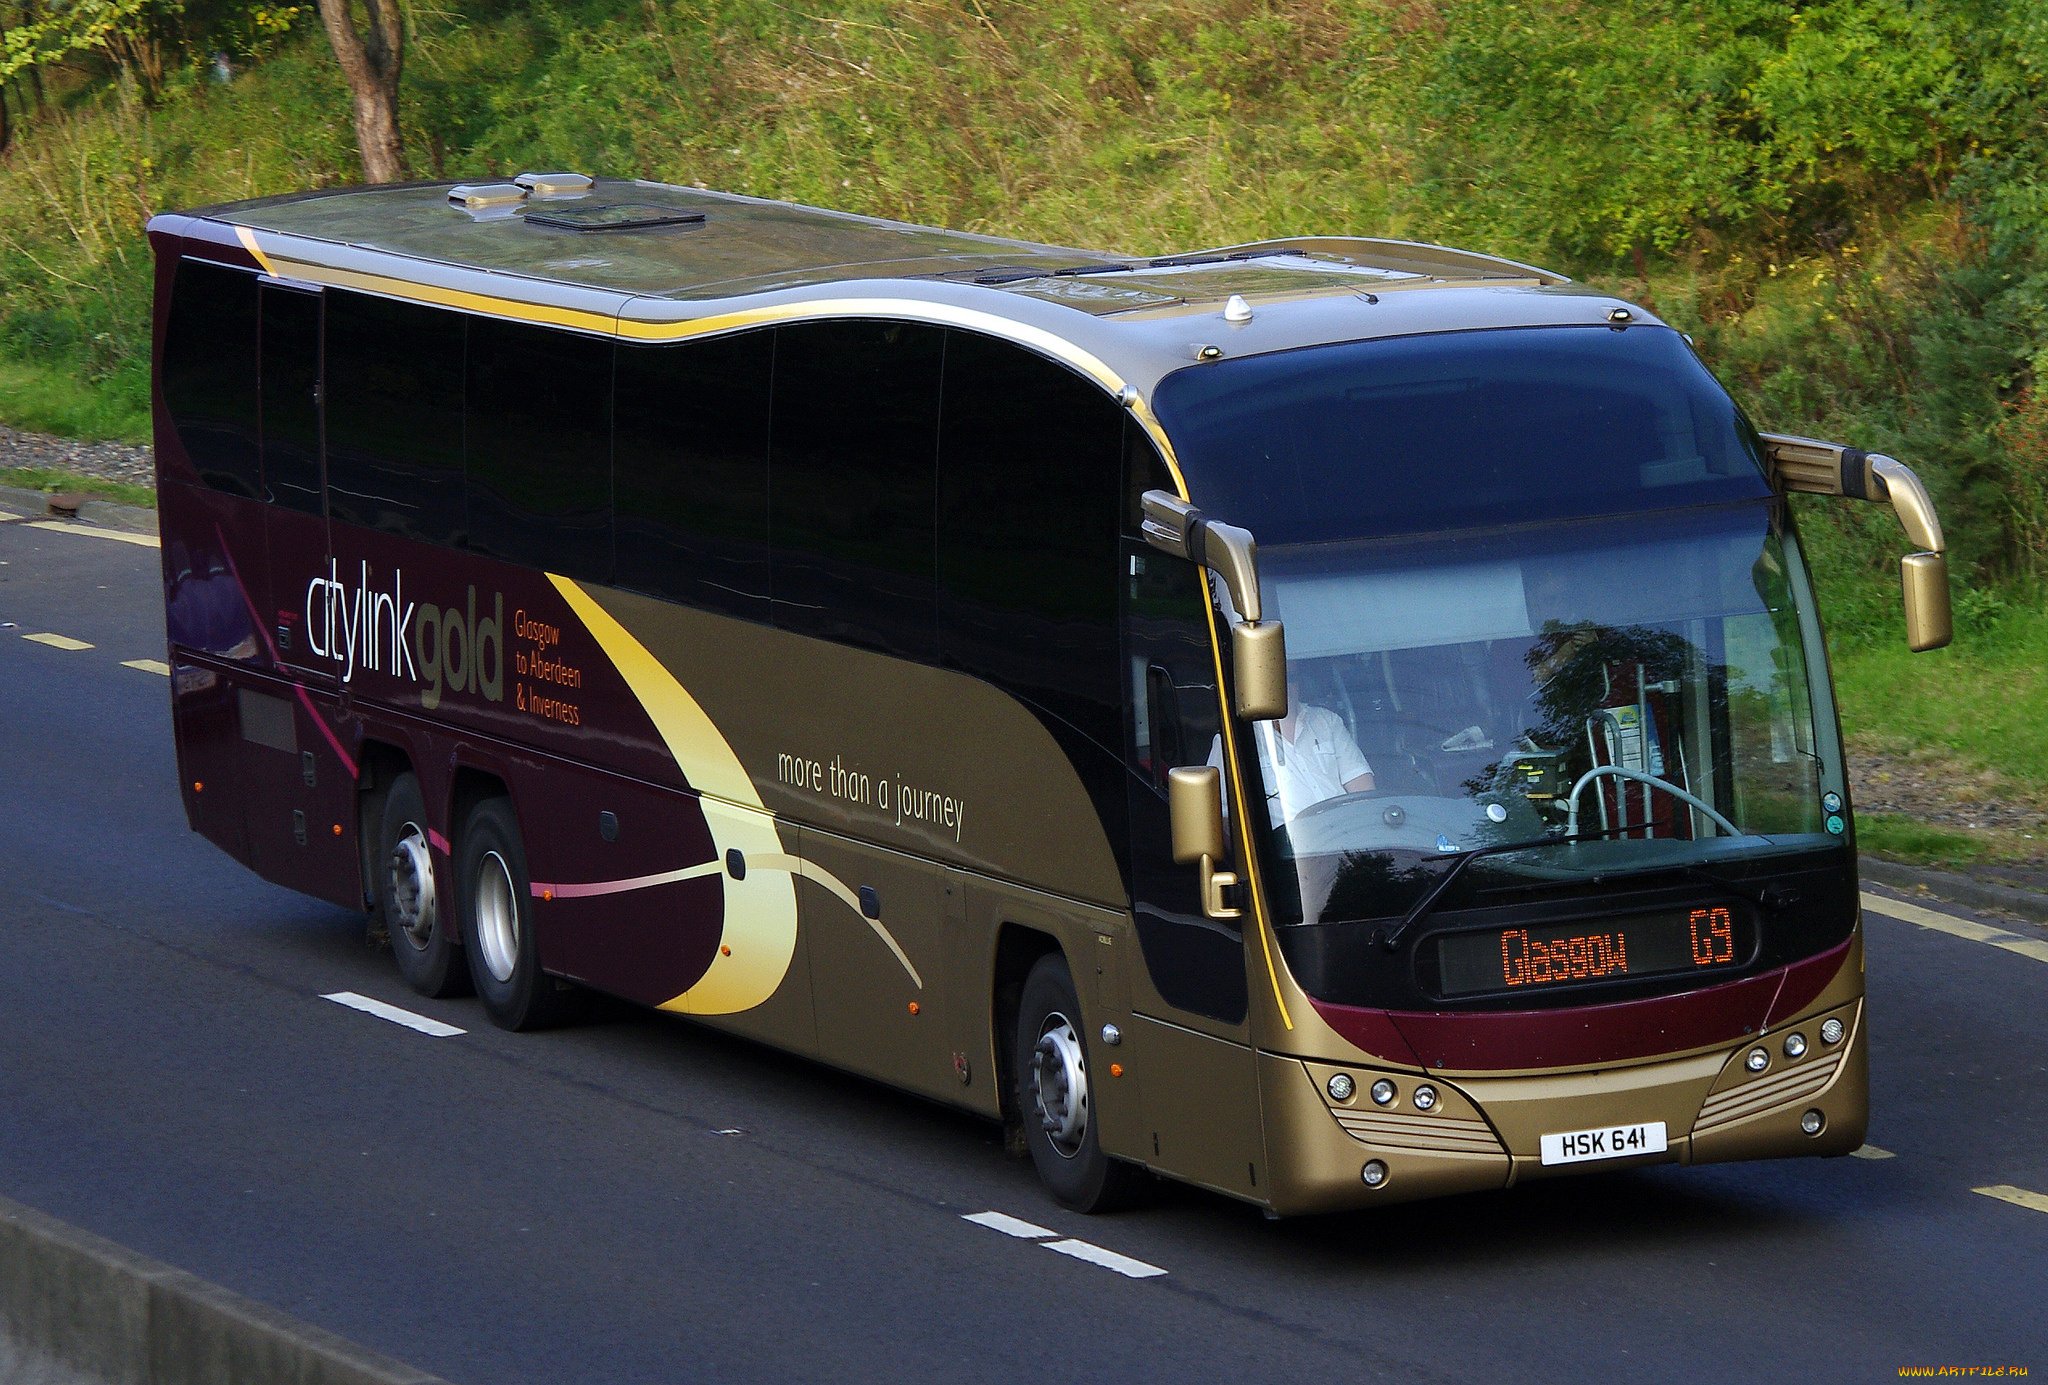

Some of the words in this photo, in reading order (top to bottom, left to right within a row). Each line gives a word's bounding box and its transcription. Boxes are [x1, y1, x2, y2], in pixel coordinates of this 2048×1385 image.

[514, 609, 559, 651] Glasgow
[516, 651, 527, 675] to
[530, 657, 581, 689] Aberdeen
[516, 682, 526, 712] &
[530, 686, 580, 726] Inverness
[778, 752, 822, 792] more
[829, 754, 870, 804] than
[878, 779, 889, 810] a
[895, 773, 964, 842] journey
[1501, 929, 1628, 986] Glasgow
[1690, 908, 1734, 965] G9
[1562, 1132, 1605, 1157] HSK
[1612, 1127, 1646, 1151] 641
